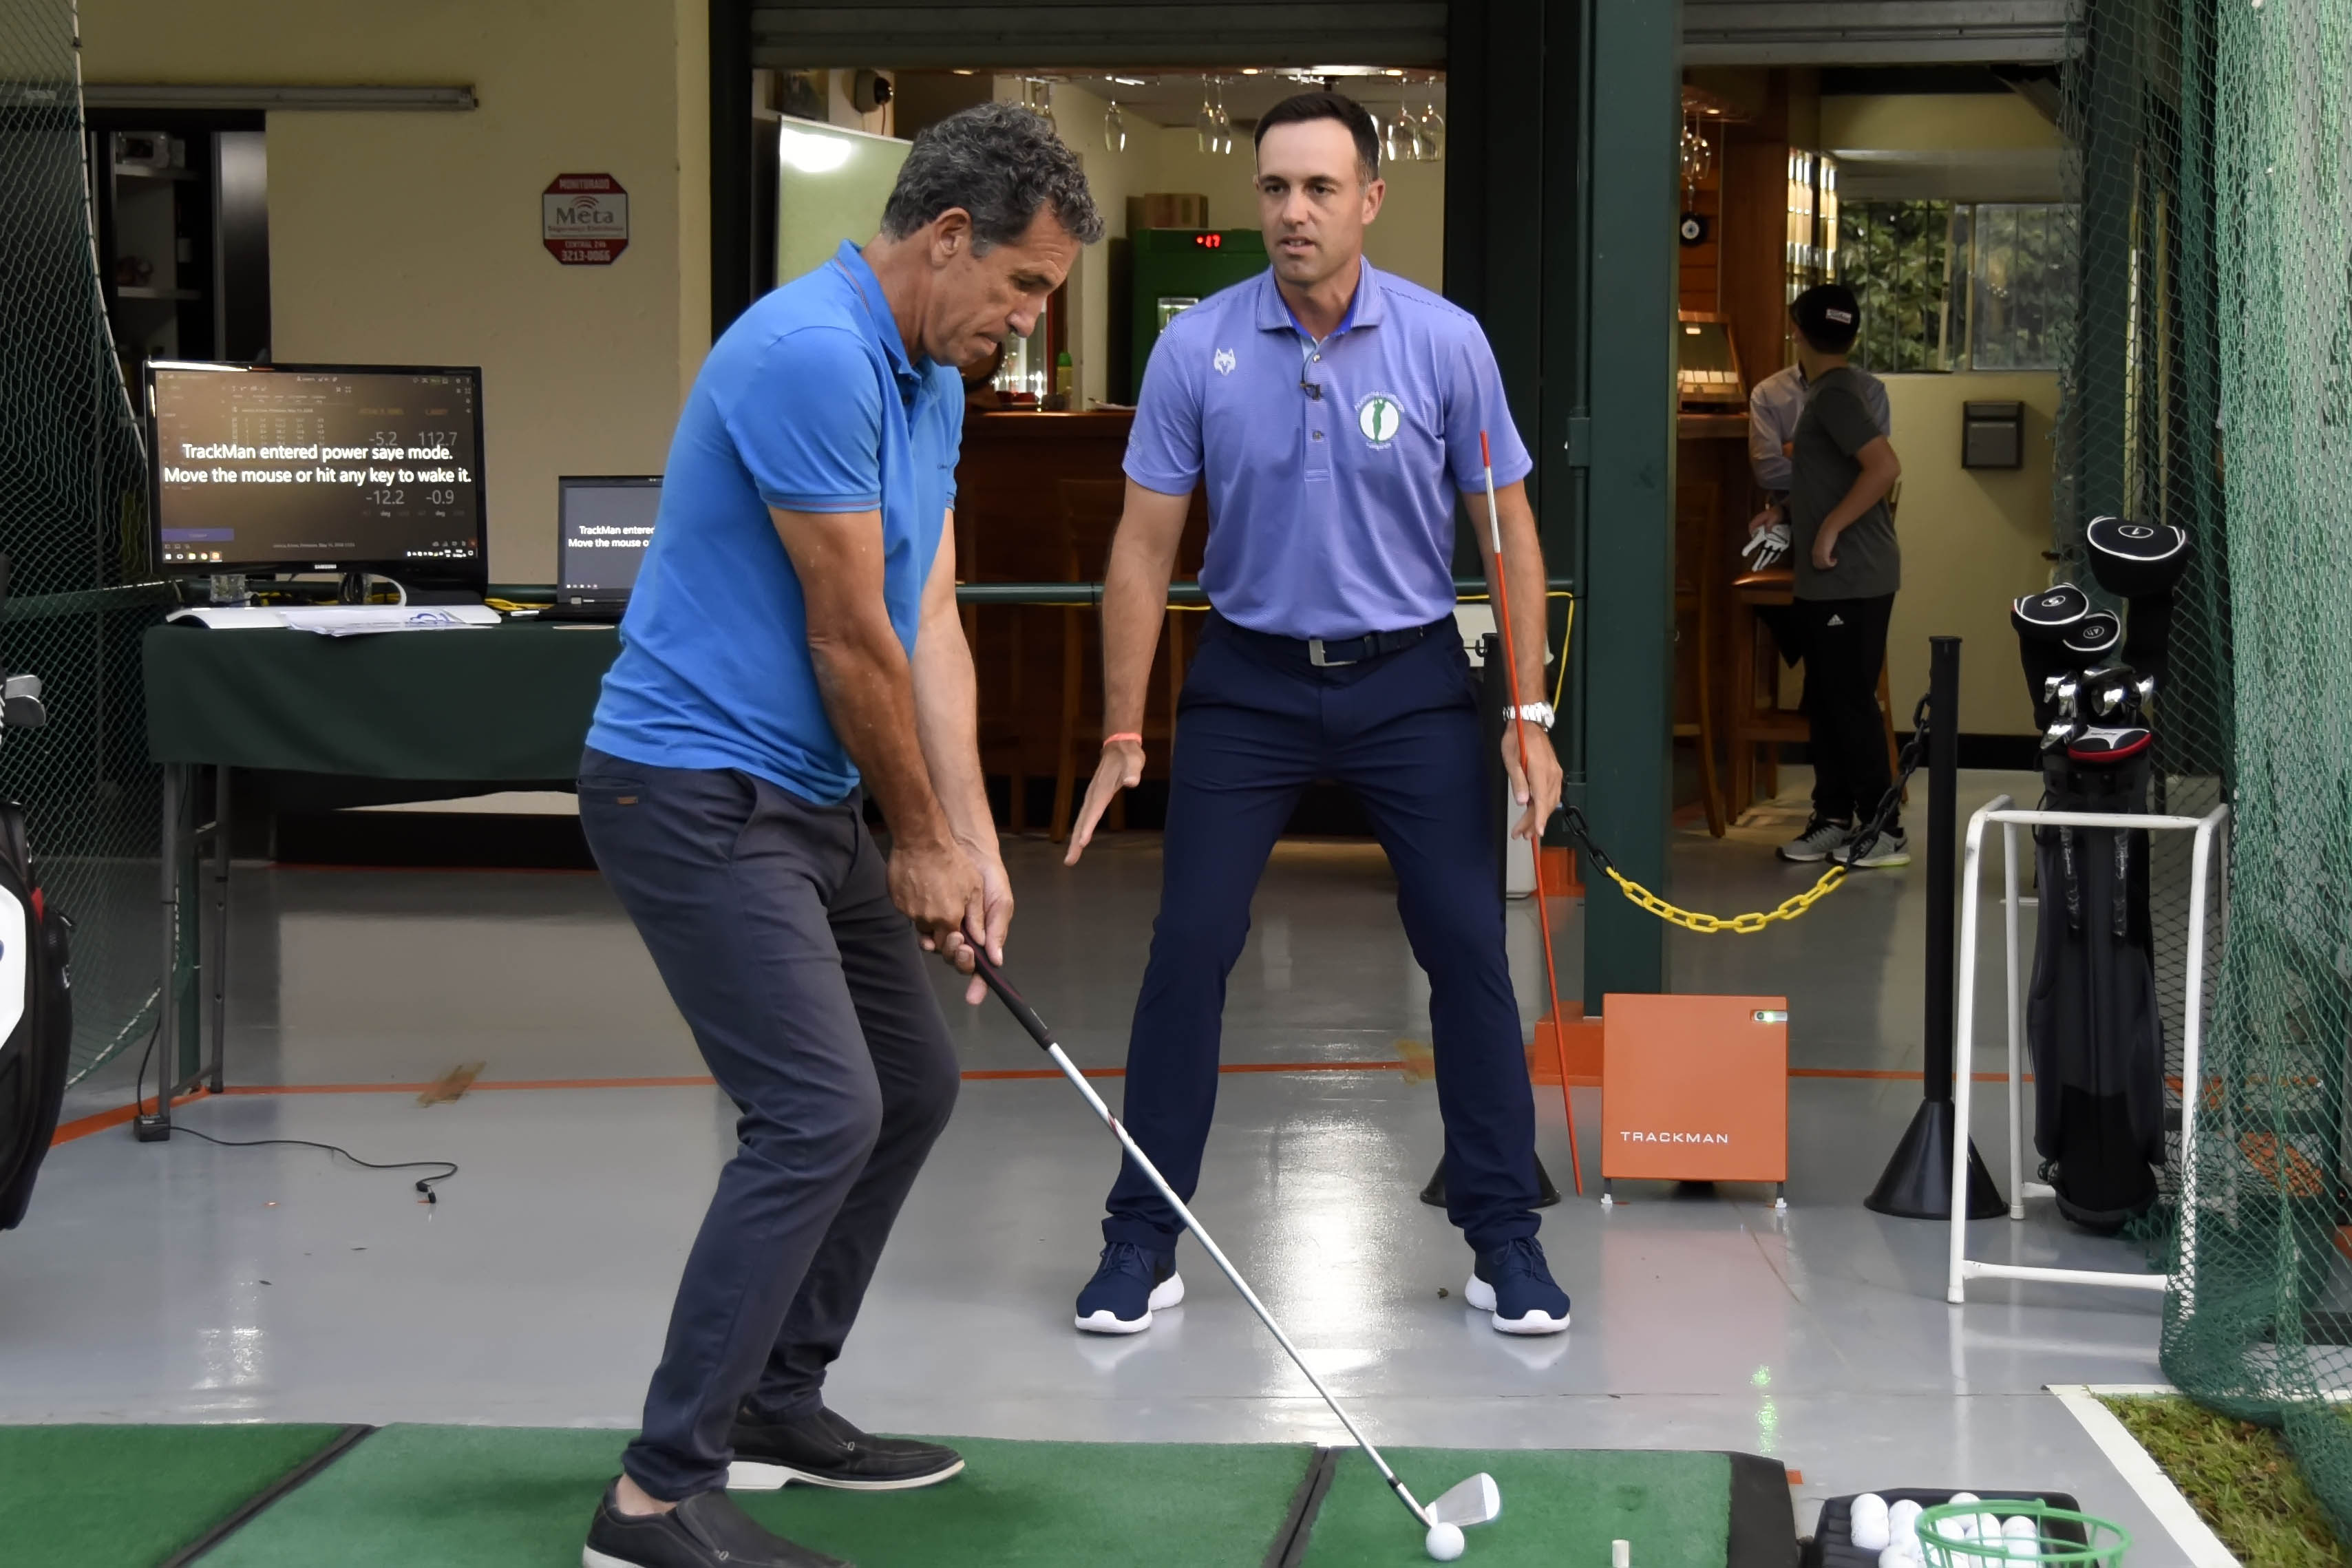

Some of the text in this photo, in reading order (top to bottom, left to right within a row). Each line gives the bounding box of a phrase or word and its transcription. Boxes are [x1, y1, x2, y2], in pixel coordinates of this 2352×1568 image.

[556, 206, 613, 225] Meta
[369, 431, 458, 447] -5.2 112.7
[182, 443, 256, 459] TrackMan
[260, 443, 318, 460] entered
[321, 447, 369, 463] power
[408, 444, 453, 460] mode.
[162, 466, 472, 487] Move the mouse or hit any key to wake it.
[365, 489, 455, 505] -12.2 -0.9
[579, 525, 622, 535] TrackMan
[568, 538, 593, 548] Move
[595, 538, 611, 548] the
[611, 539, 642, 548] mouse
[1620, 1131, 1728, 1143] TRACKMAN
